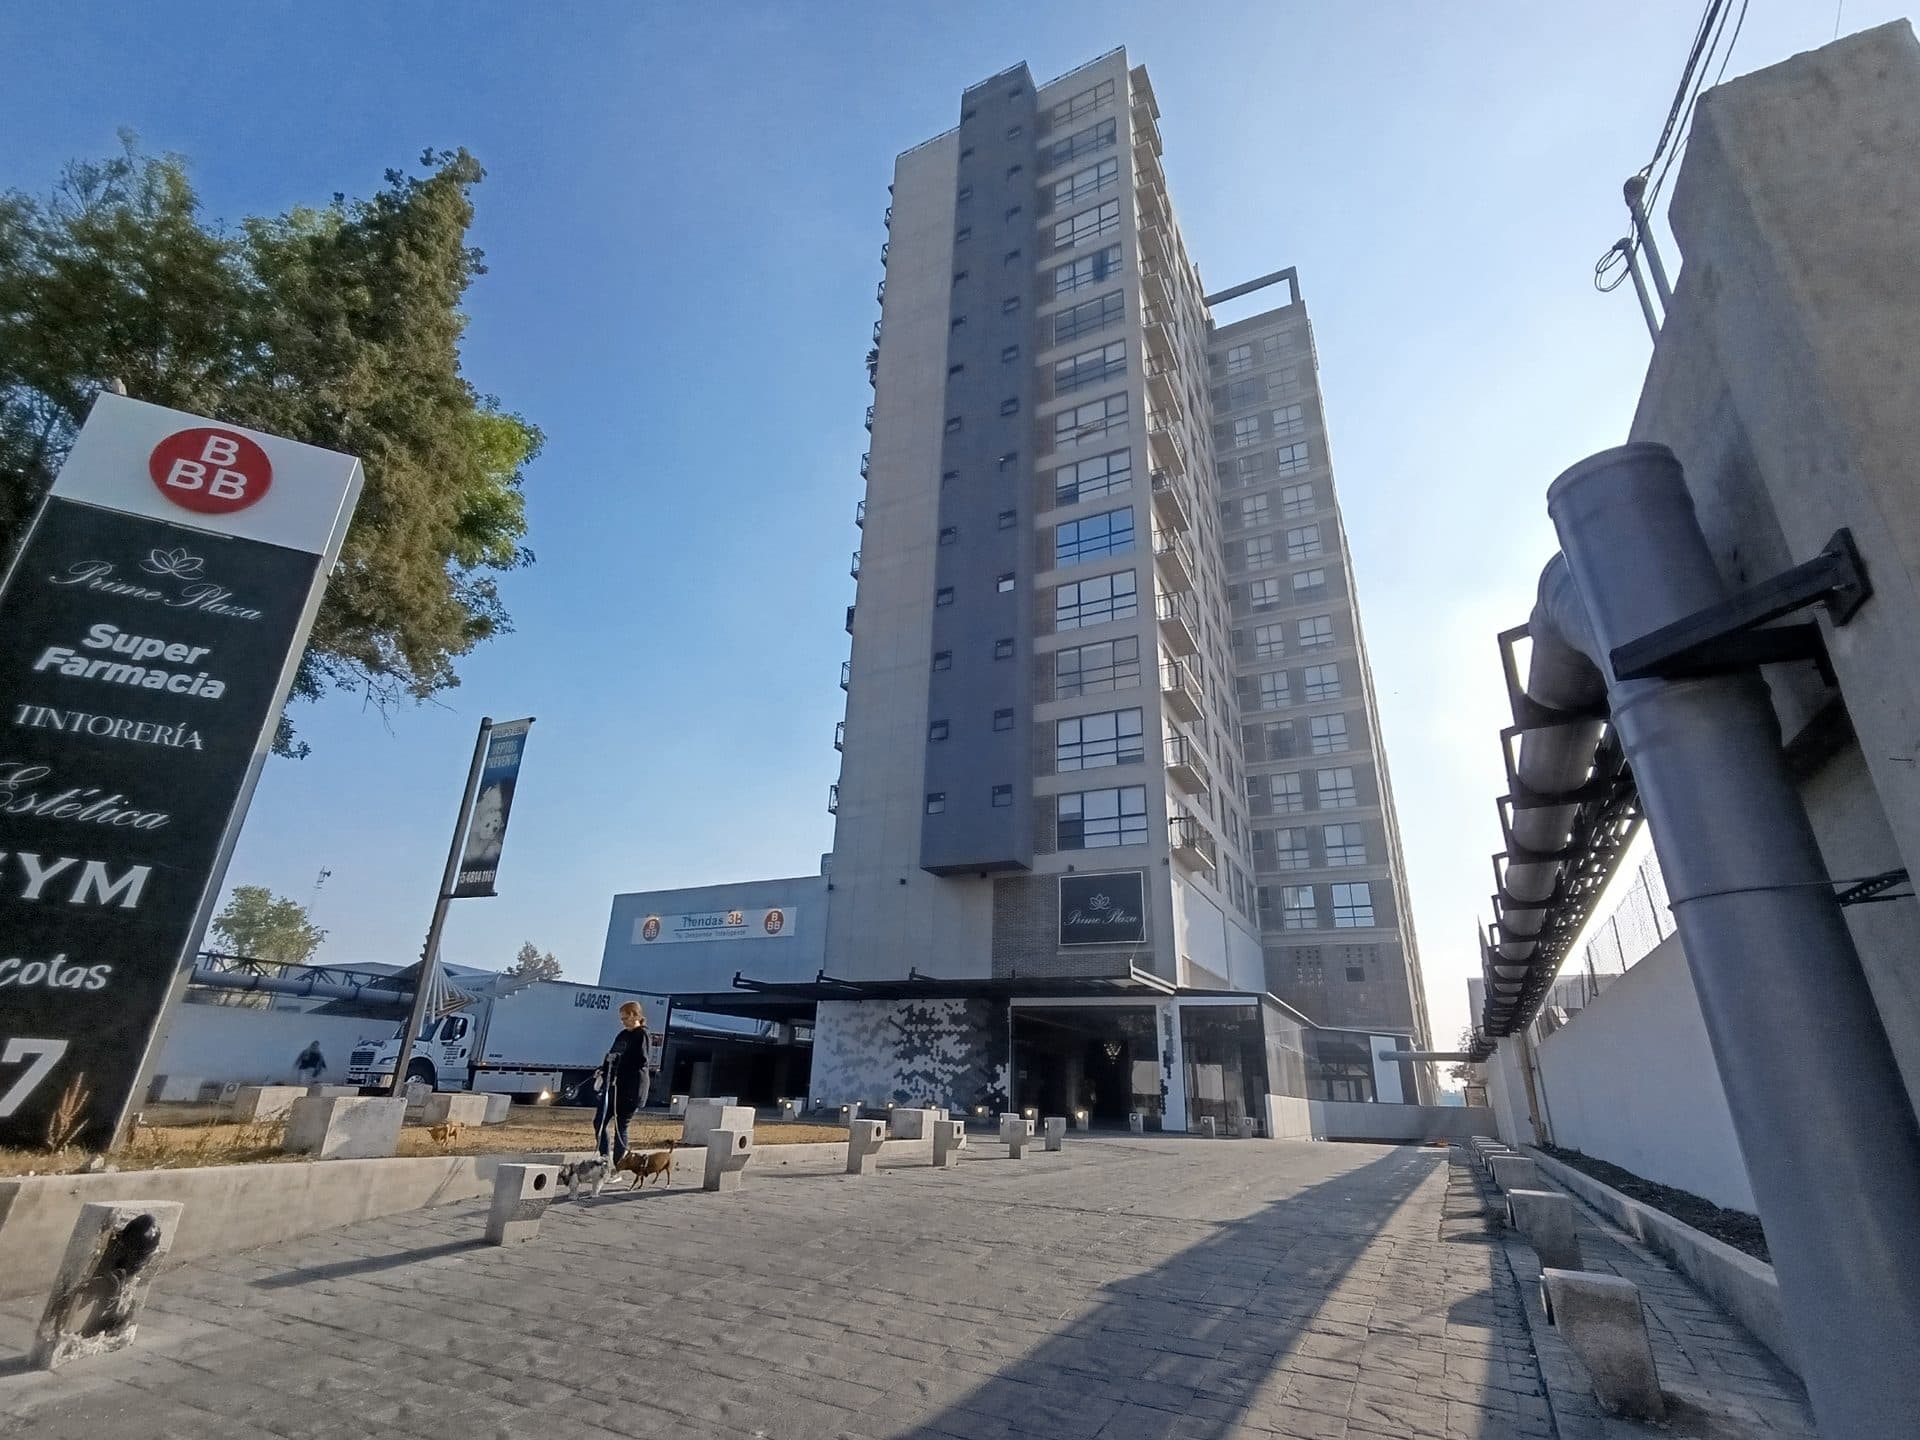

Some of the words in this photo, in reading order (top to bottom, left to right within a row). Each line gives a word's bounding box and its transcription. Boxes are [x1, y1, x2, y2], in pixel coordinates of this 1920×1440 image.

[50, 560, 162, 601] Prime
[164, 583, 264, 621] Plaza
[82, 623, 210, 665] Super
[33, 646, 225, 700] Farmacia
[15, 703, 203, 750] TINTORERÍA
[0, 851, 153, 909] YM
[682, 916, 724, 928] Tiendas
